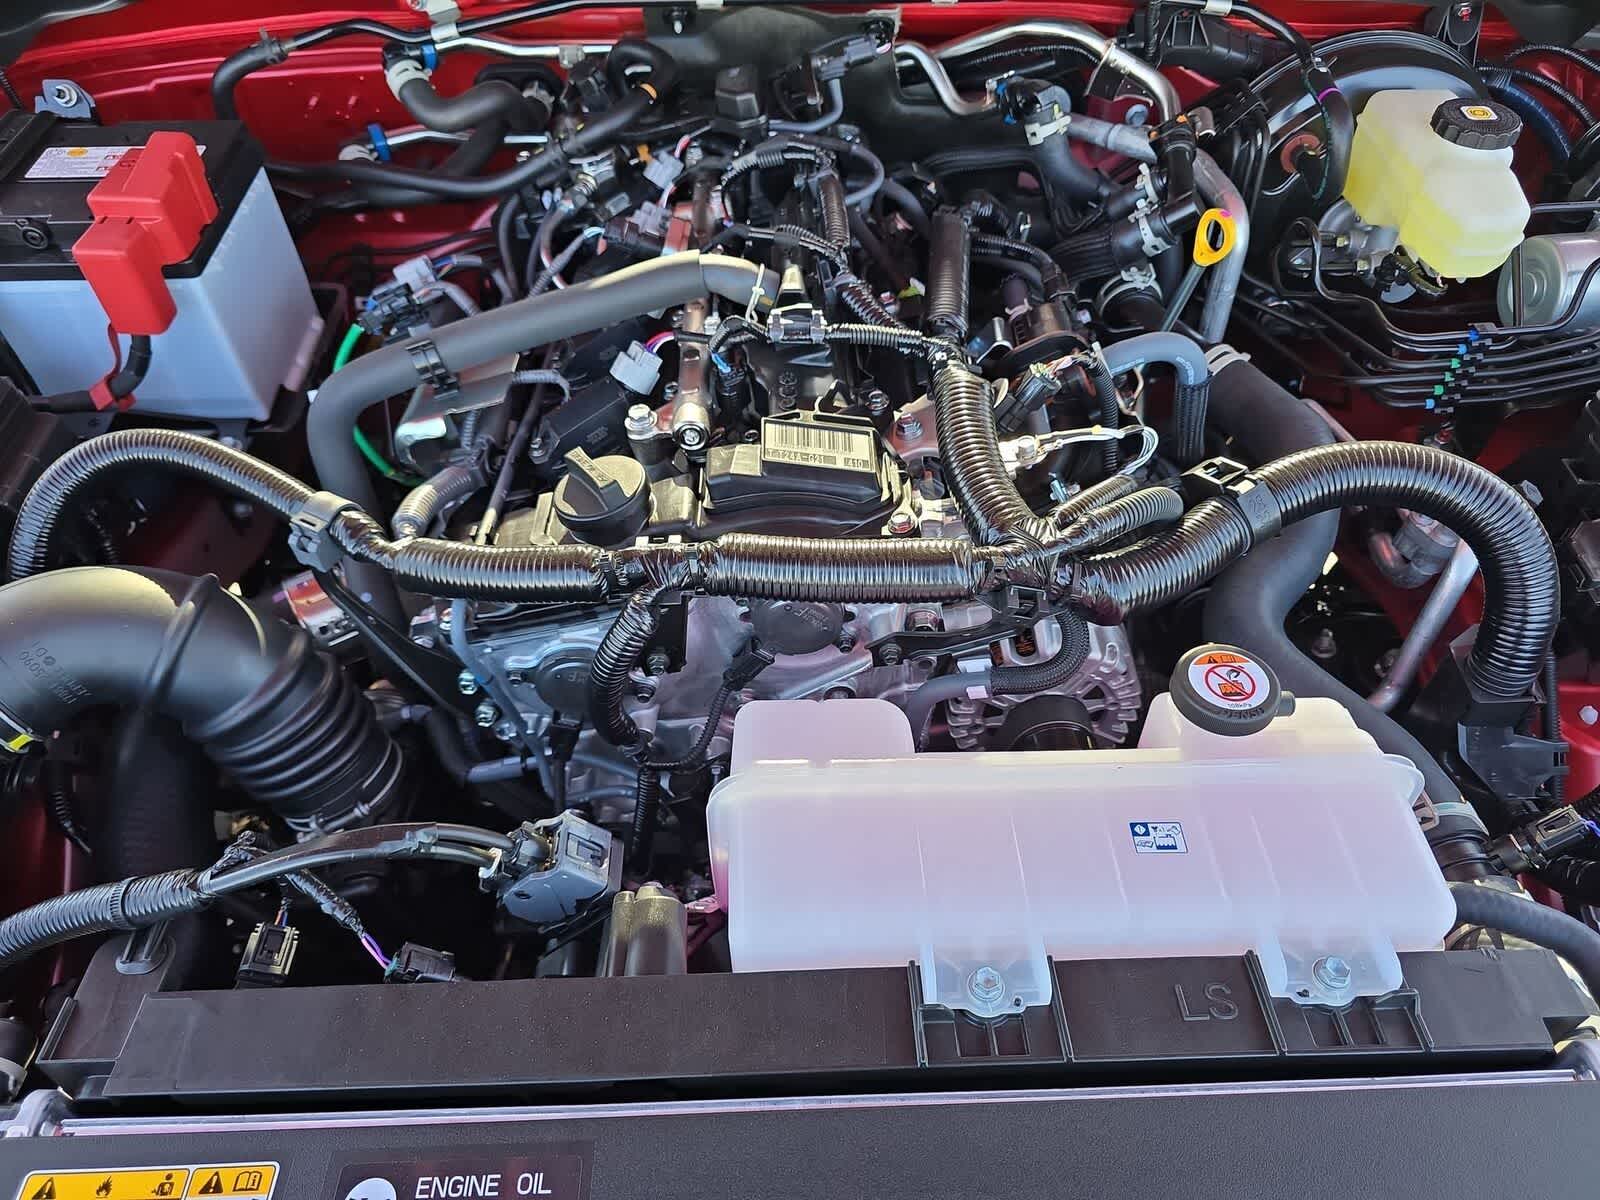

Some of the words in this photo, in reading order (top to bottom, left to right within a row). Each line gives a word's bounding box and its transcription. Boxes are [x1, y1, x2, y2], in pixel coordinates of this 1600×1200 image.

[1174, 982, 1239, 1021] LS
[415, 1173, 502, 1199] ENGINE
[516, 1172, 552, 1196] OIL
